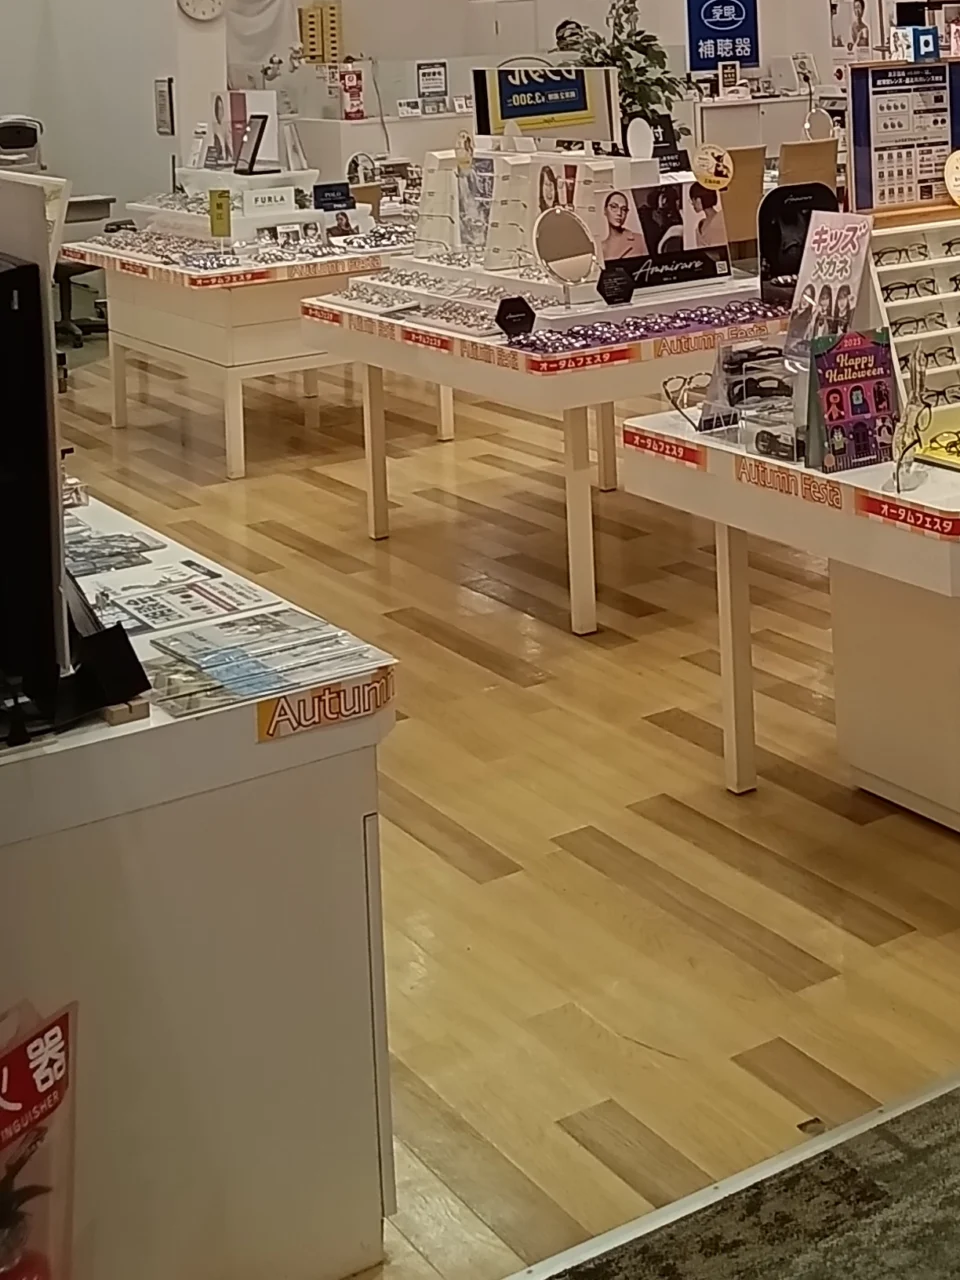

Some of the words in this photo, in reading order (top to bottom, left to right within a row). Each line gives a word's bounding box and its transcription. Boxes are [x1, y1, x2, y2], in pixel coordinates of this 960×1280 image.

[712, 6, 736, 20] 愛眼
[698, 38, 751, 59] 補聴器
[254, 195, 285, 206] FURLA
[812, 221, 868, 254] キッズ
[812, 254, 851, 280] メガネ
[540, 352, 610, 371] オータムフェスタ
[836, 352, 875, 376] Happy
[825, 366, 885, 384] Halloween
[633, 437, 684, 458] オータムフェスタ
[737, 458, 799, 497] Autumn
[801, 475, 843, 509] Festa
[880, 503, 953, 533] オータムフェスタ
[267, 670, 395, 737] Autumn
[0, 1090, 60, 1144] INGUISHER
